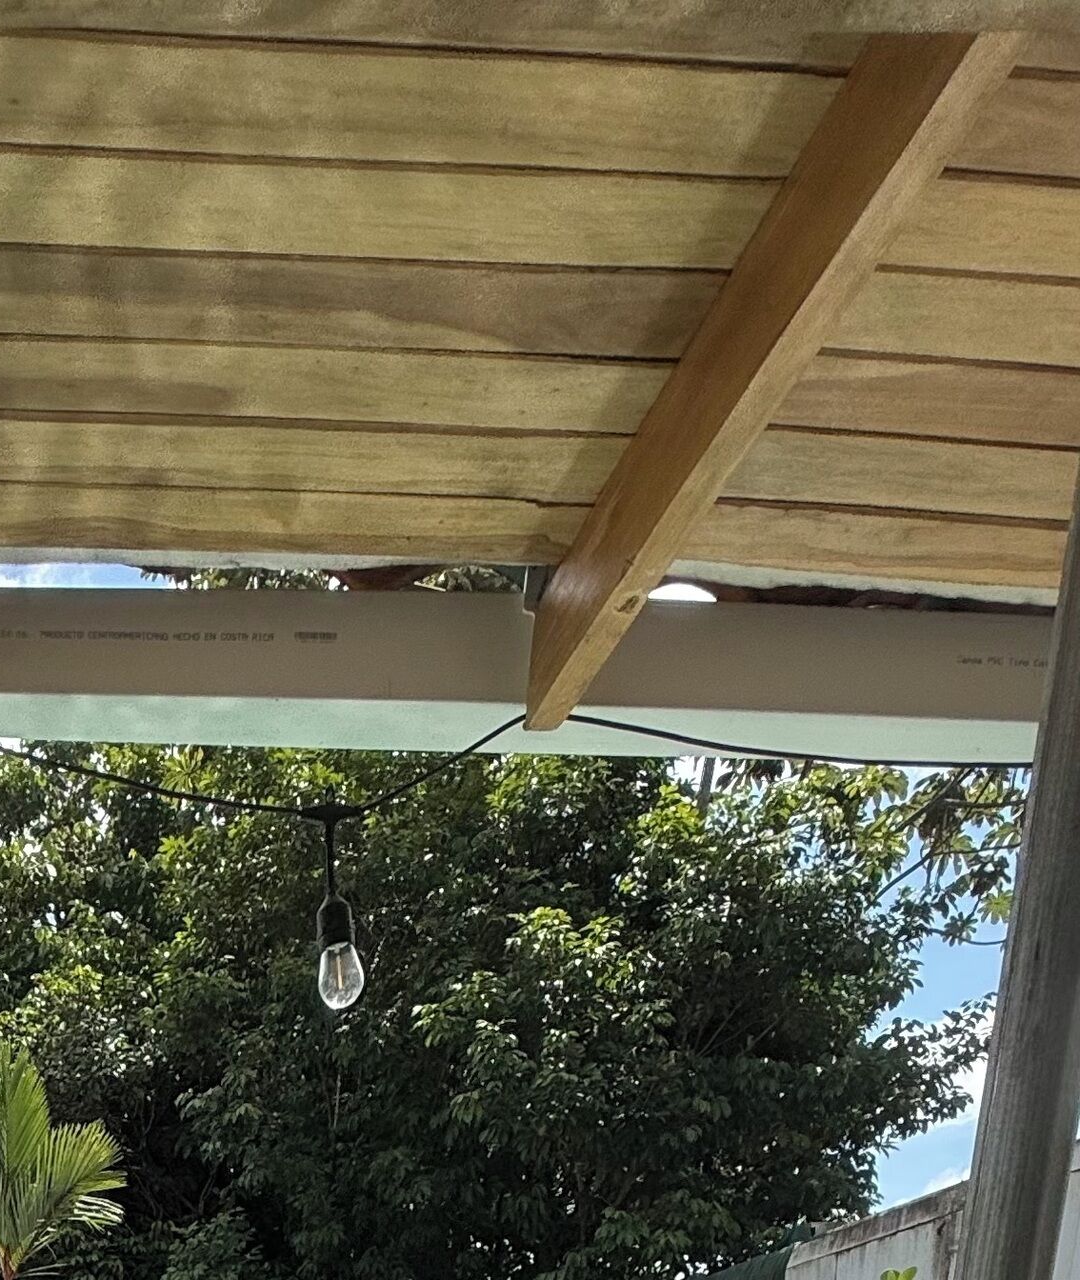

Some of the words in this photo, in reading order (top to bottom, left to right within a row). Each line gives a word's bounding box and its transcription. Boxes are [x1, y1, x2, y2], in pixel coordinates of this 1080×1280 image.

[87, 630, 169, 641] CENTROAMERICANO
[204, 632, 217, 642] EN
[220, 632, 249, 642] COSTA
[251, 633, 274, 642] RICA
